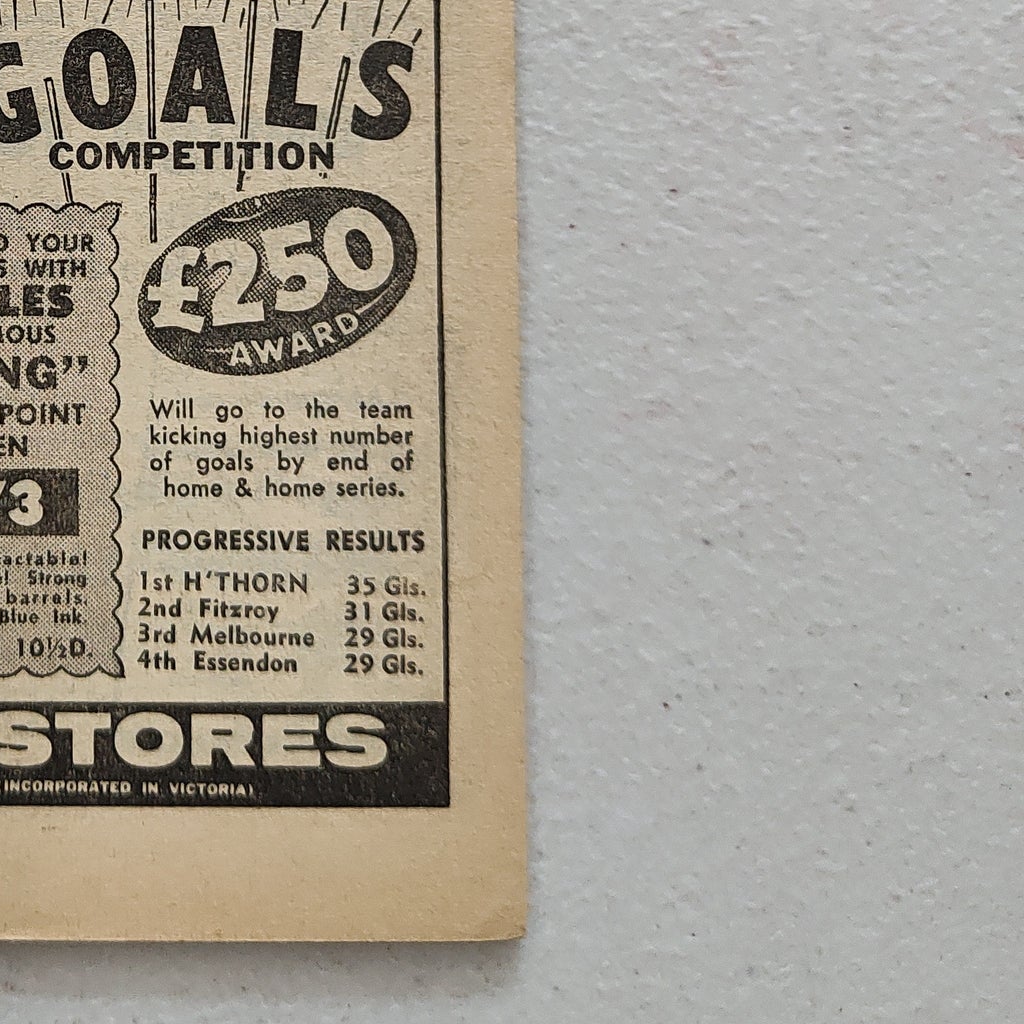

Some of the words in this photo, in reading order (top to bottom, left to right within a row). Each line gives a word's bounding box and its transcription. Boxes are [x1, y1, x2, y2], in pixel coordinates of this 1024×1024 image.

[49, 140, 336, 171] COMPETITION
[27, 233, 95, 252] YOUR
[25, 259, 87, 278] WITH
[147, 206, 395, 334] £250
[228, 312, 360, 367] AWARD
[149, 398, 194, 419] Will
[215, 404, 243, 422] go
[264, 401, 285, 419] to
[305, 398, 339, 419] the
[359, 401, 413, 419] team
[149, 424, 226, 447] kicking
[240, 424, 318, 448] highest
[330, 424, 414, 445] number
[149, 450, 173, 472] of
[196, 450, 254, 475] goals
[277, 450, 305, 475] by
[327, 450, 369, 471] end
[390, 449, 414, 471] of
[163, 476, 223, 497] home
[235, 477, 252, 497] &
[265, 475, 326, 497] home
[336, 477, 405, 497] series.
[141, 529, 310, 552] PROGRESSIVE
[326, 530, 425, 553] RESULTS
[27, 570, 88, 587] Strong
[139, 571, 173, 591] 1st
[346, 575, 377, 596] 35
[384, 576, 426, 596] Gls.
[0, 608, 40, 624] Blue
[138, 598, 182, 618] 2nd
[199, 598, 279, 623] Fitzroy
[344, 601, 371, 621] 31
[381, 601, 424, 622] Gls.
[138, 623, 176, 644] 3rd
[190, 623, 315, 647] Melbourne
[344, 627, 375, 647] 29
[381, 627, 424, 649] Gls.
[137, 649, 176, 670] 4th
[193, 650, 298, 673] Essendon
[343, 653, 374, 673] 29
[381, 653, 424, 675] Gls.
[141, 781, 159, 794] IN
[169, 782, 254, 796] VICTORIA)
